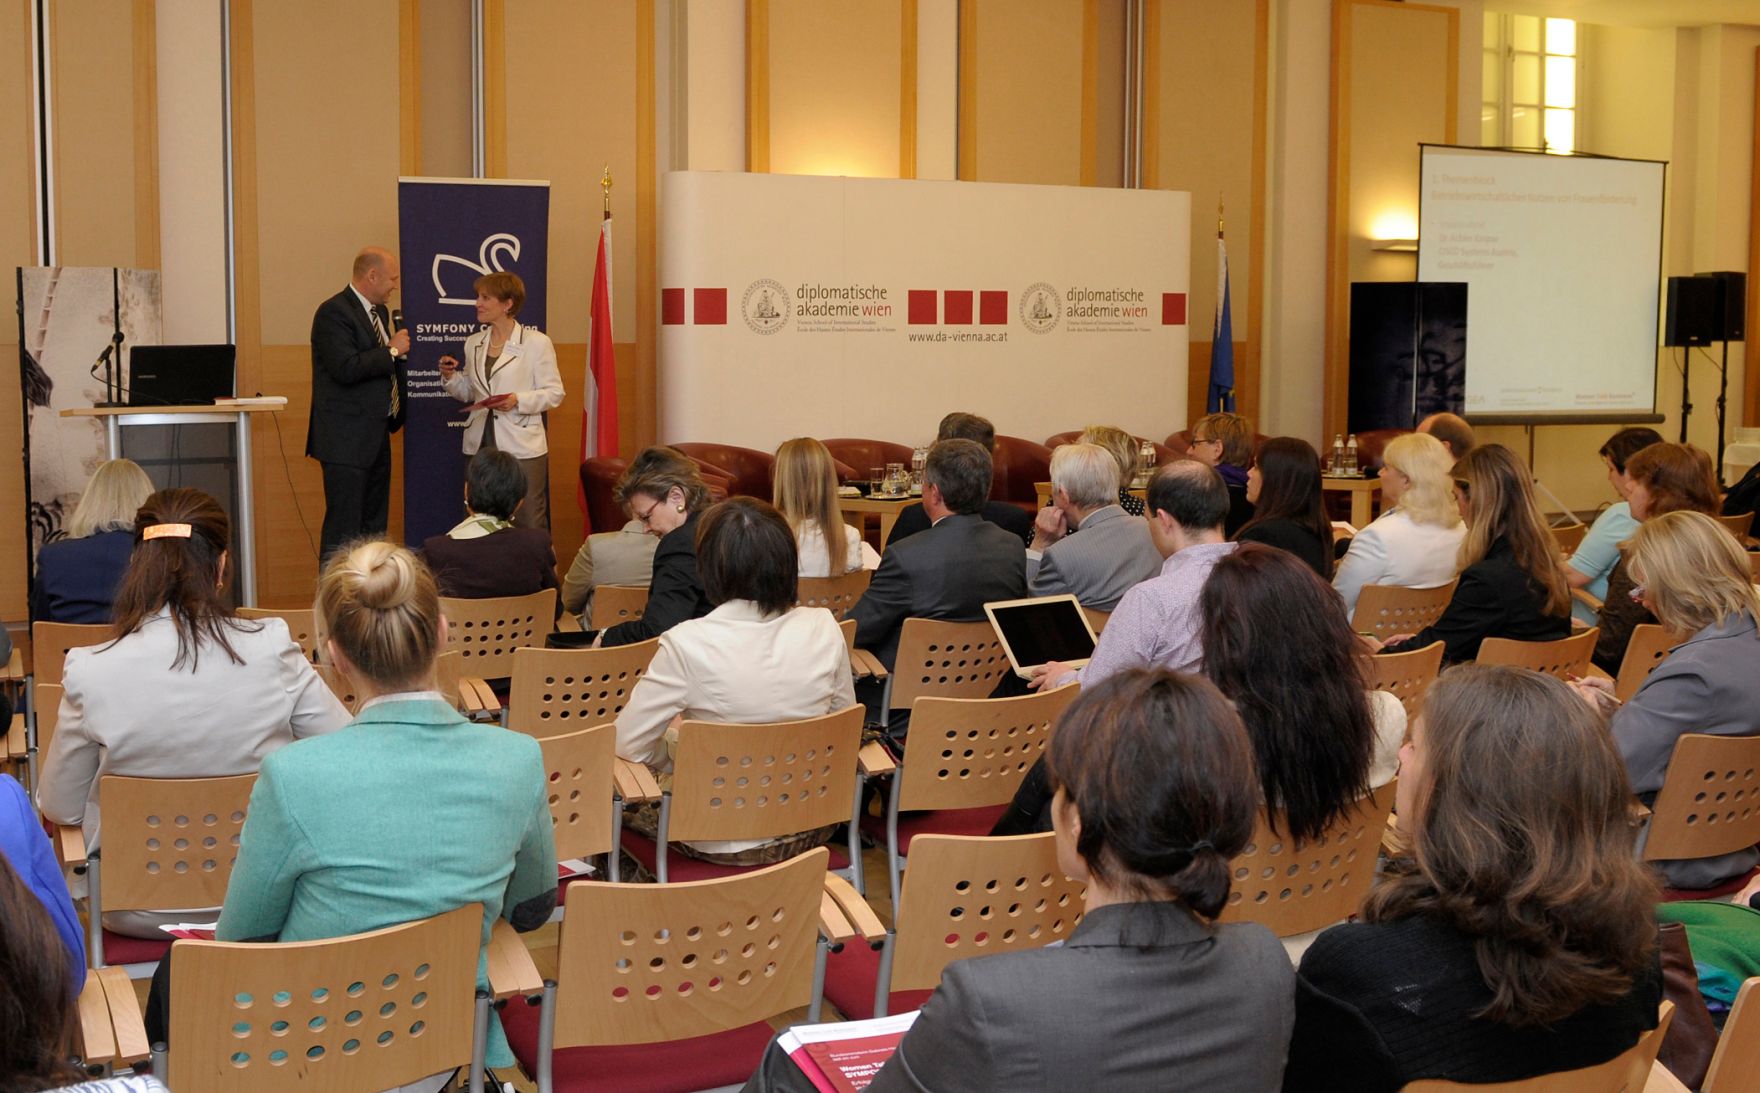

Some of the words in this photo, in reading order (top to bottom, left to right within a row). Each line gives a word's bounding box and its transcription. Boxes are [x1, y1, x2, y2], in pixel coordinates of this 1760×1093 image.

[797, 283, 887, 303] diplomatische
[1067, 286, 1144, 305] diplomatische
[797, 301, 859, 317] akademie
[861, 301, 892, 317] wien
[1067, 303, 1120, 317] akademie
[1121, 303, 1147, 317] wien
[416, 323, 475, 333] SYMFONY
[416, 335, 443, 343] Creating
[908, 330, 1008, 342] www.da-vienna.ac.at
[839, 1064, 872, 1073] Women
